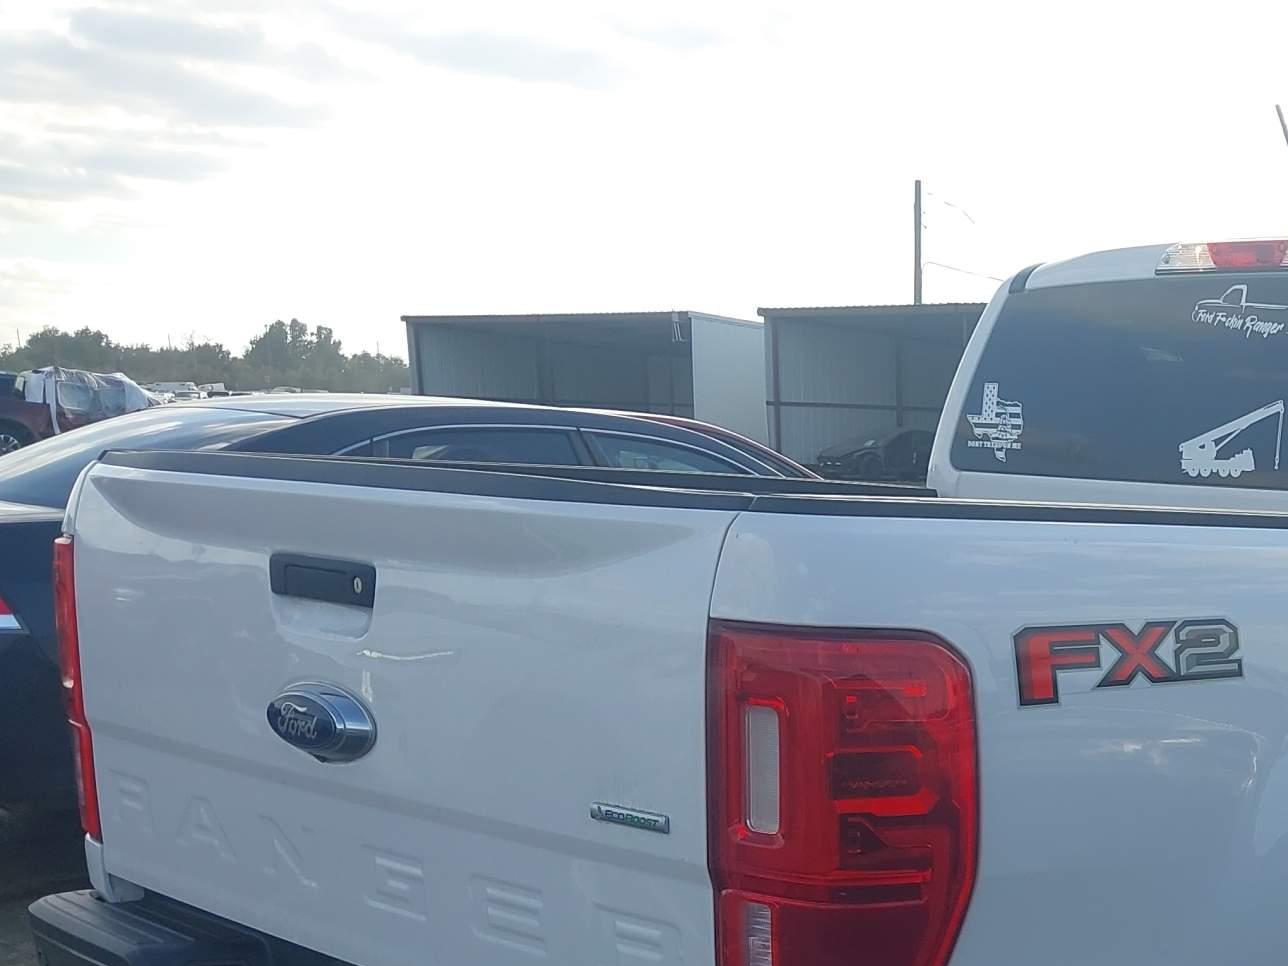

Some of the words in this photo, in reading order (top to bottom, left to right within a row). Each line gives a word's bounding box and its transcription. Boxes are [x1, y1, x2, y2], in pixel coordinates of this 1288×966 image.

[1243, 315, 1285, 338] Ranger
[1012, 618, 1243, 707] FX2
[277, 701, 318, 740] Ford
